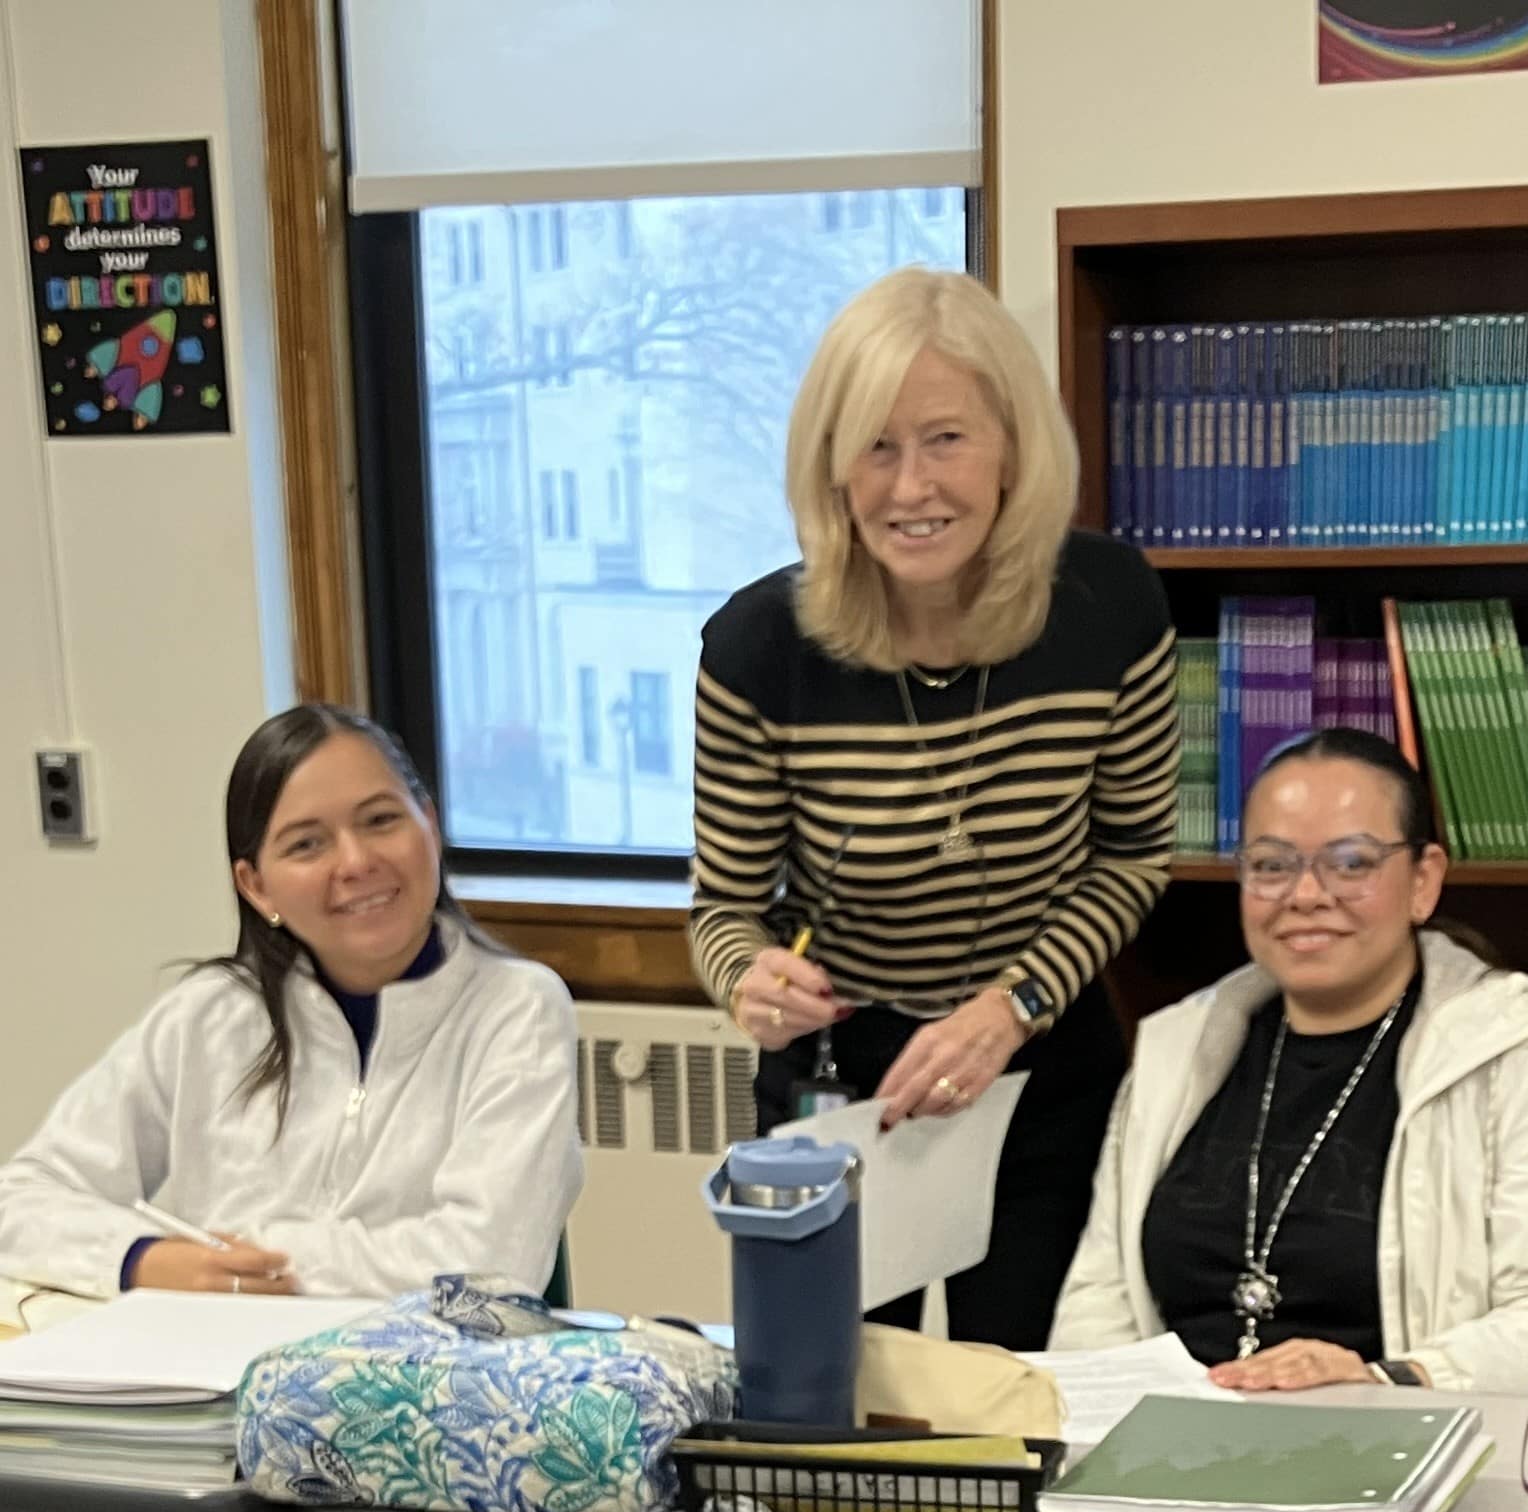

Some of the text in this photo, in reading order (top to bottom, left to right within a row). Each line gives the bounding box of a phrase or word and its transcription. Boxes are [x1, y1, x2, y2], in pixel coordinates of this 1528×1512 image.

[87, 165, 139, 188] Your
[65, 224, 181, 250] determines
[100, 252, 149, 273] your
